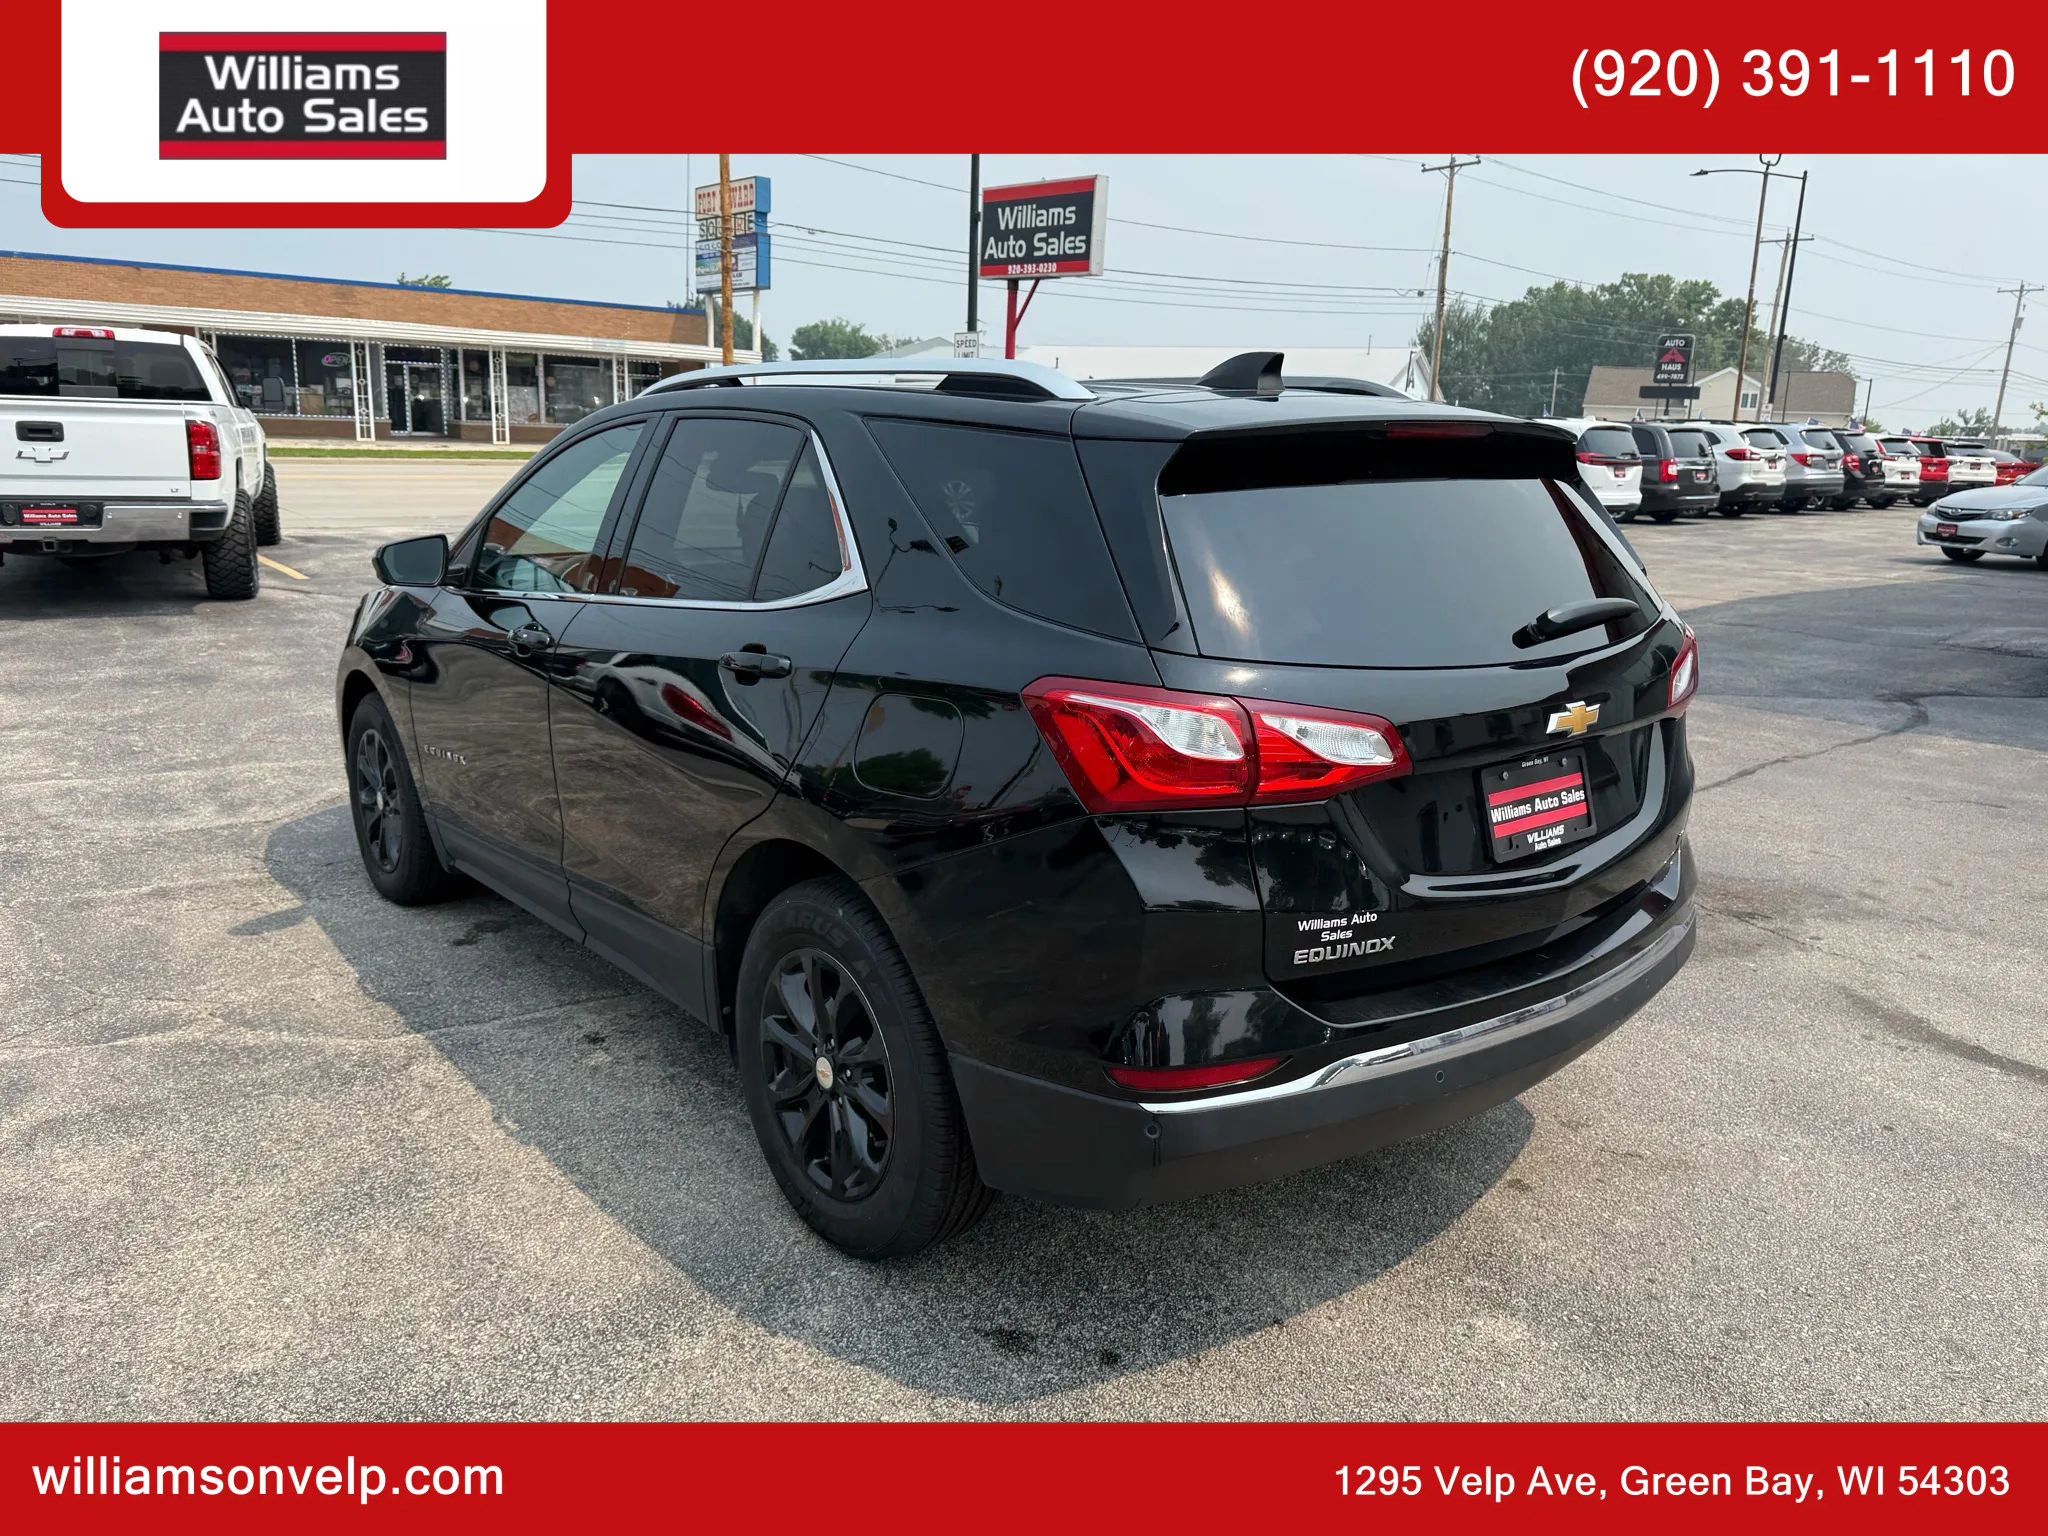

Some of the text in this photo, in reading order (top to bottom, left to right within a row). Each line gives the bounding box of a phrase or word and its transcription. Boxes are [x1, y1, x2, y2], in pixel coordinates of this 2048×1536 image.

[997, 204, 1077, 231] Williams
[984, 231, 1087, 260] Auto Sales
[1007, 262, 1057, 275] 920-393-0230
[956, 339, 977, 348] SPEED
[1664, 339, 1686, 347] AUTO
[1661, 363, 1682, 371] HAUS
[1490, 789, 1585, 823] Williams Auto Sales
[1526, 824, 1565, 844] WILLIAMS
[1534, 841, 1548, 851] Auto
[1297, 911, 1378, 931] Williams Auto
[1320, 929, 1353, 942] Sales
[1293, 935, 1396, 965] EQUINOX
